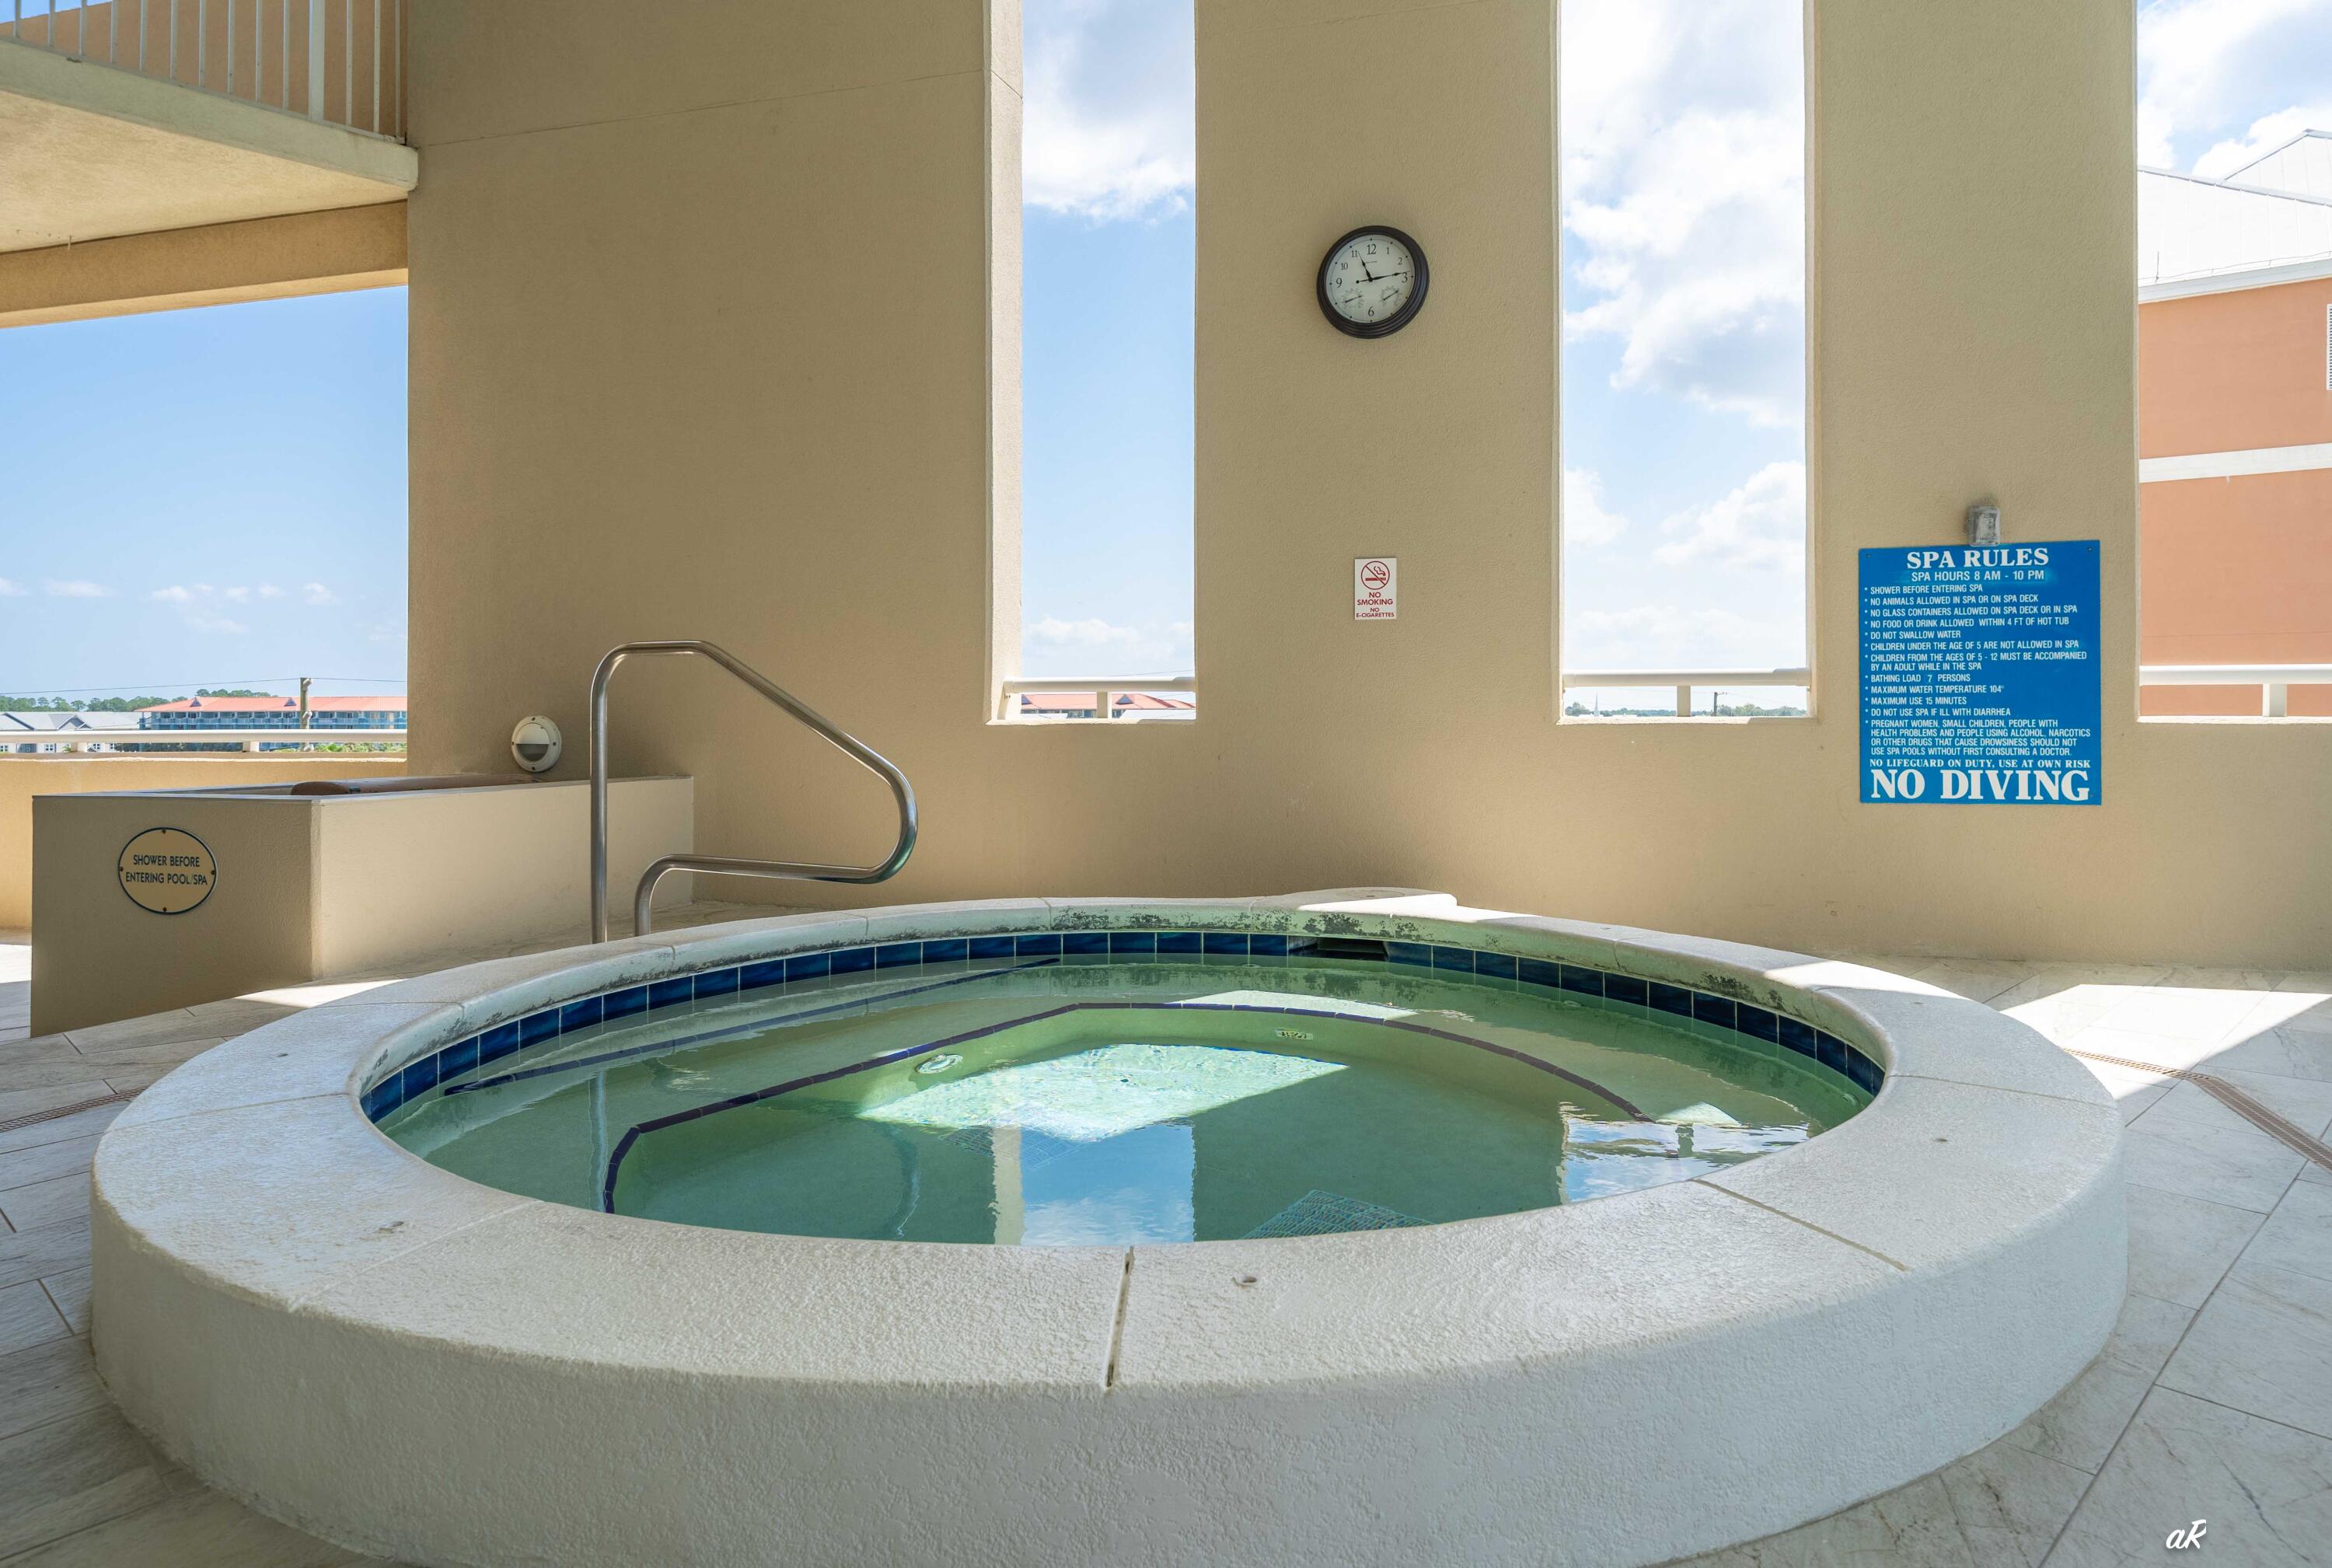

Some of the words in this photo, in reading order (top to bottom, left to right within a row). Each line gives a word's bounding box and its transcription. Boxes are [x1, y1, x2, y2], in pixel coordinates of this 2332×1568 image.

[1367, 243, 1376, 254] 12
[1351, 250, 1357, 258] 11
[1341, 262, 1349, 271] 10
[1401, 272, 1408, 283] 3
[1335, 278, 1342, 288] 9
[1368, 306, 1374, 317] 6
[1907, 550, 1955, 569] SPA
[1964, 548, 2049, 568] RULES
[1912, 571, 1930, 581] SPA
[1935, 571, 1970, 581] HOURS
[1974, 571, 1980, 581] 8
[1985, 571, 2001, 580] AM
[2013, 571, 2023, 580] 10
[2028, 571, 2044, 580] PM
[1883, 597, 1915, 606] ANIMALS
[1916, 596, 1950, 605] ALLOWED
[1871, 642, 1904, 651] CHILDREN
[2000, 641, 2015, 649] NOT
[2034, 651, 2086, 660] ACCOMPANIED
[1903, 674, 1921, 683] LOAD
[1928, 674, 1932, 683] 7
[1935, 685, 1987, 693] TEMPERATURE
[1935, 697, 1967, 705] MINUTES
[2009, 719, 2037, 728] PEOPLE
[2038, 719, 2058, 728] WITH
[1965, 760, 1995, 768] DUTY,
[1999, 760, 2018, 768] USE
[2022, 760, 2034, 768] AT
[2037, 760, 2061, 768] OWN
[1871, 769, 1925, 799] NO
[1940, 769, 2089, 801] DIVING
[133, 854, 167, 866] SHOWER
[169, 856, 200, 867] BEFORE
[125, 871, 165, 883] ENTERING
